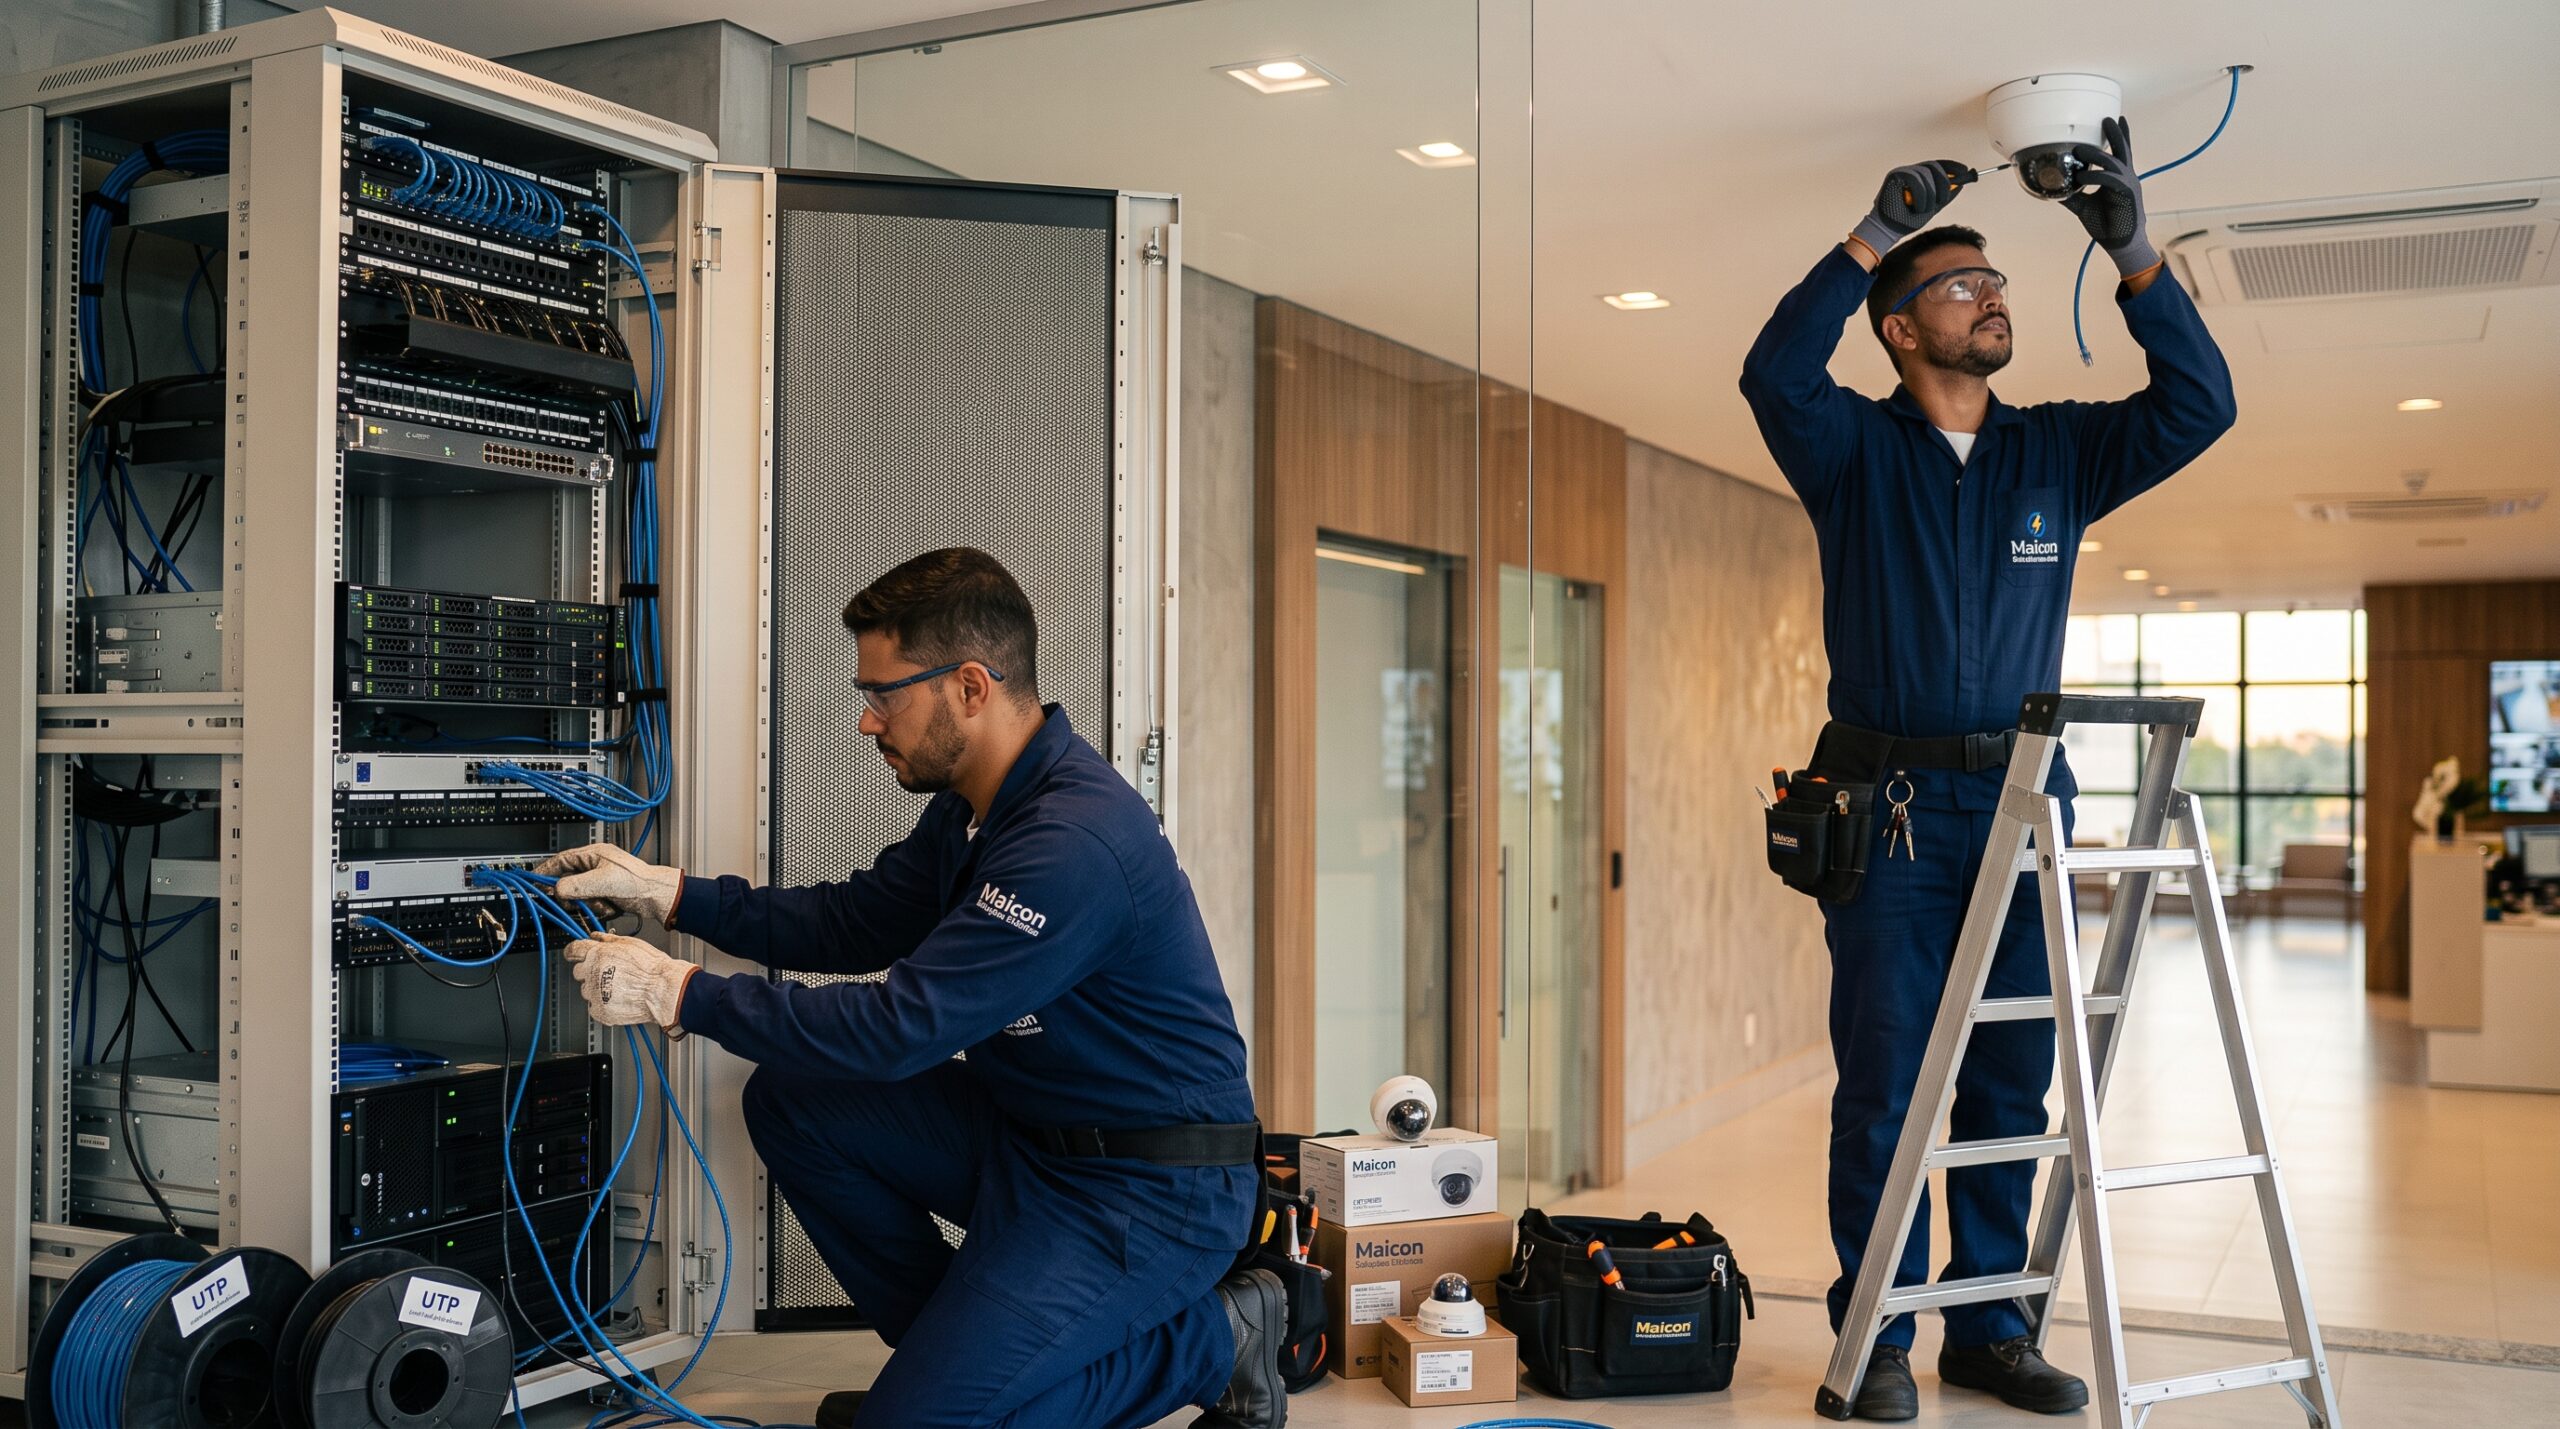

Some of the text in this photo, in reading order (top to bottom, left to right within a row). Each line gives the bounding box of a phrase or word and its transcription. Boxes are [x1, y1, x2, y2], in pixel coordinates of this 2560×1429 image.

[2011, 540, 2058, 555] Maicon
[980, 883, 1047, 929] Maicon
[1353, 1159, 1396, 1172] Maicon
[1355, 1240, 1424, 1259] Maicon
[192, 1277, 228, 1311] UTP
[422, 1290, 460, 1313] UTP
[1636, 1321, 1692, 1334] Maicon
